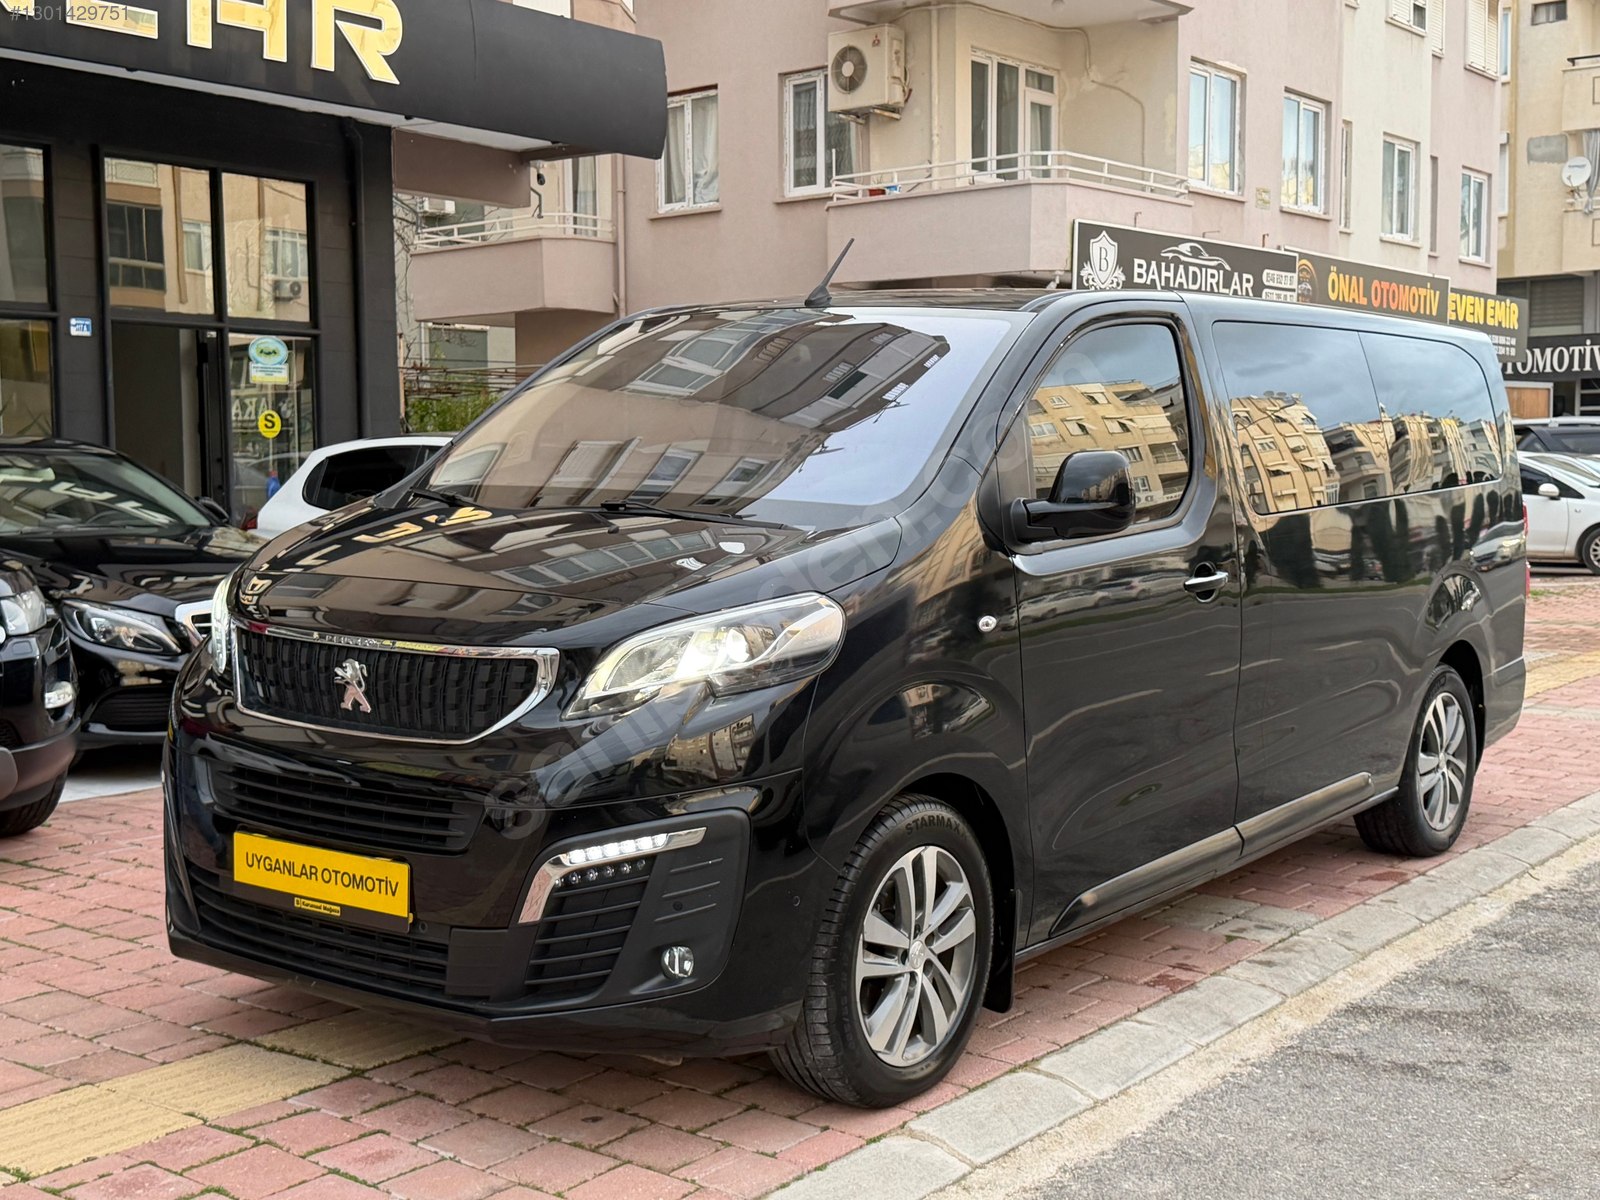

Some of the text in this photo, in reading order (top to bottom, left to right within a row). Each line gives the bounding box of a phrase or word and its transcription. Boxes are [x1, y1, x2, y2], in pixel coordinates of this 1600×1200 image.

[1098, 246, 1109, 272] B
[1133, 257, 1254, 297] BAHADIRLAR
[1328, 265, 1441, 317] ÖNAL OTOMOTİV
[264, 413, 276, 429] S
[905, 814, 961, 836] STARMAX
[246, 851, 399, 897] UYGANLAR OTOMOTİV
